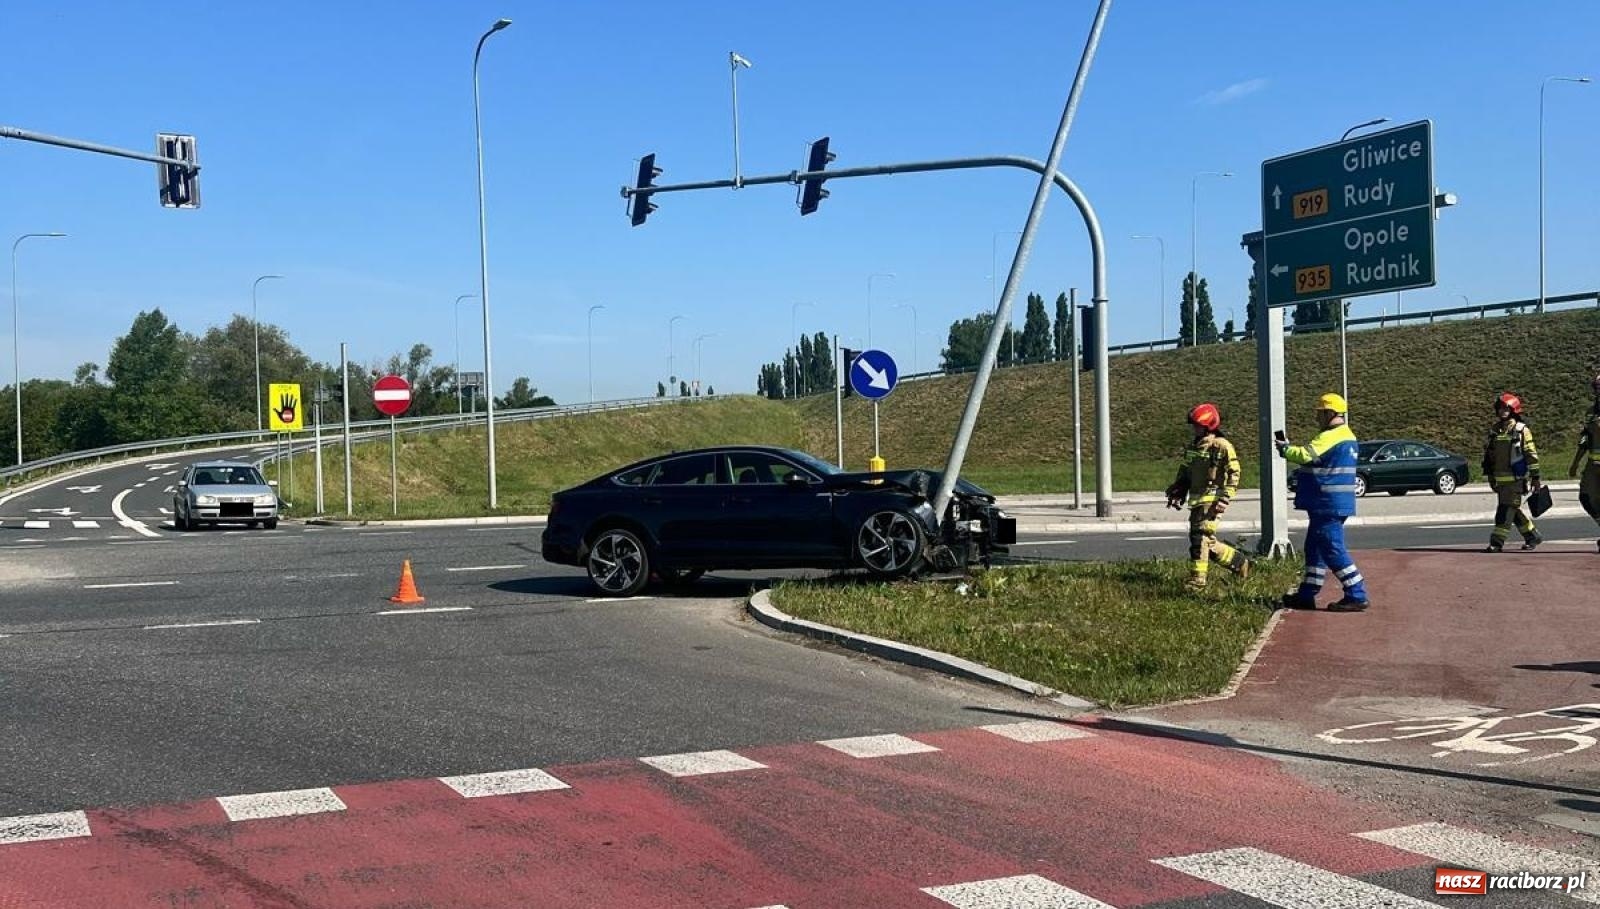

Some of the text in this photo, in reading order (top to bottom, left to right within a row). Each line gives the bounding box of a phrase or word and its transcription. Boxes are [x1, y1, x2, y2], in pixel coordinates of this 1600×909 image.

[1343, 139, 1422, 172] Gliwice
[1300, 194, 1323, 214] 919
[1344, 178, 1395, 208] Rudy
[1344, 220, 1409, 254] Opole
[1298, 270, 1326, 289] 935
[1347, 253, 1420, 285] Rudnik
